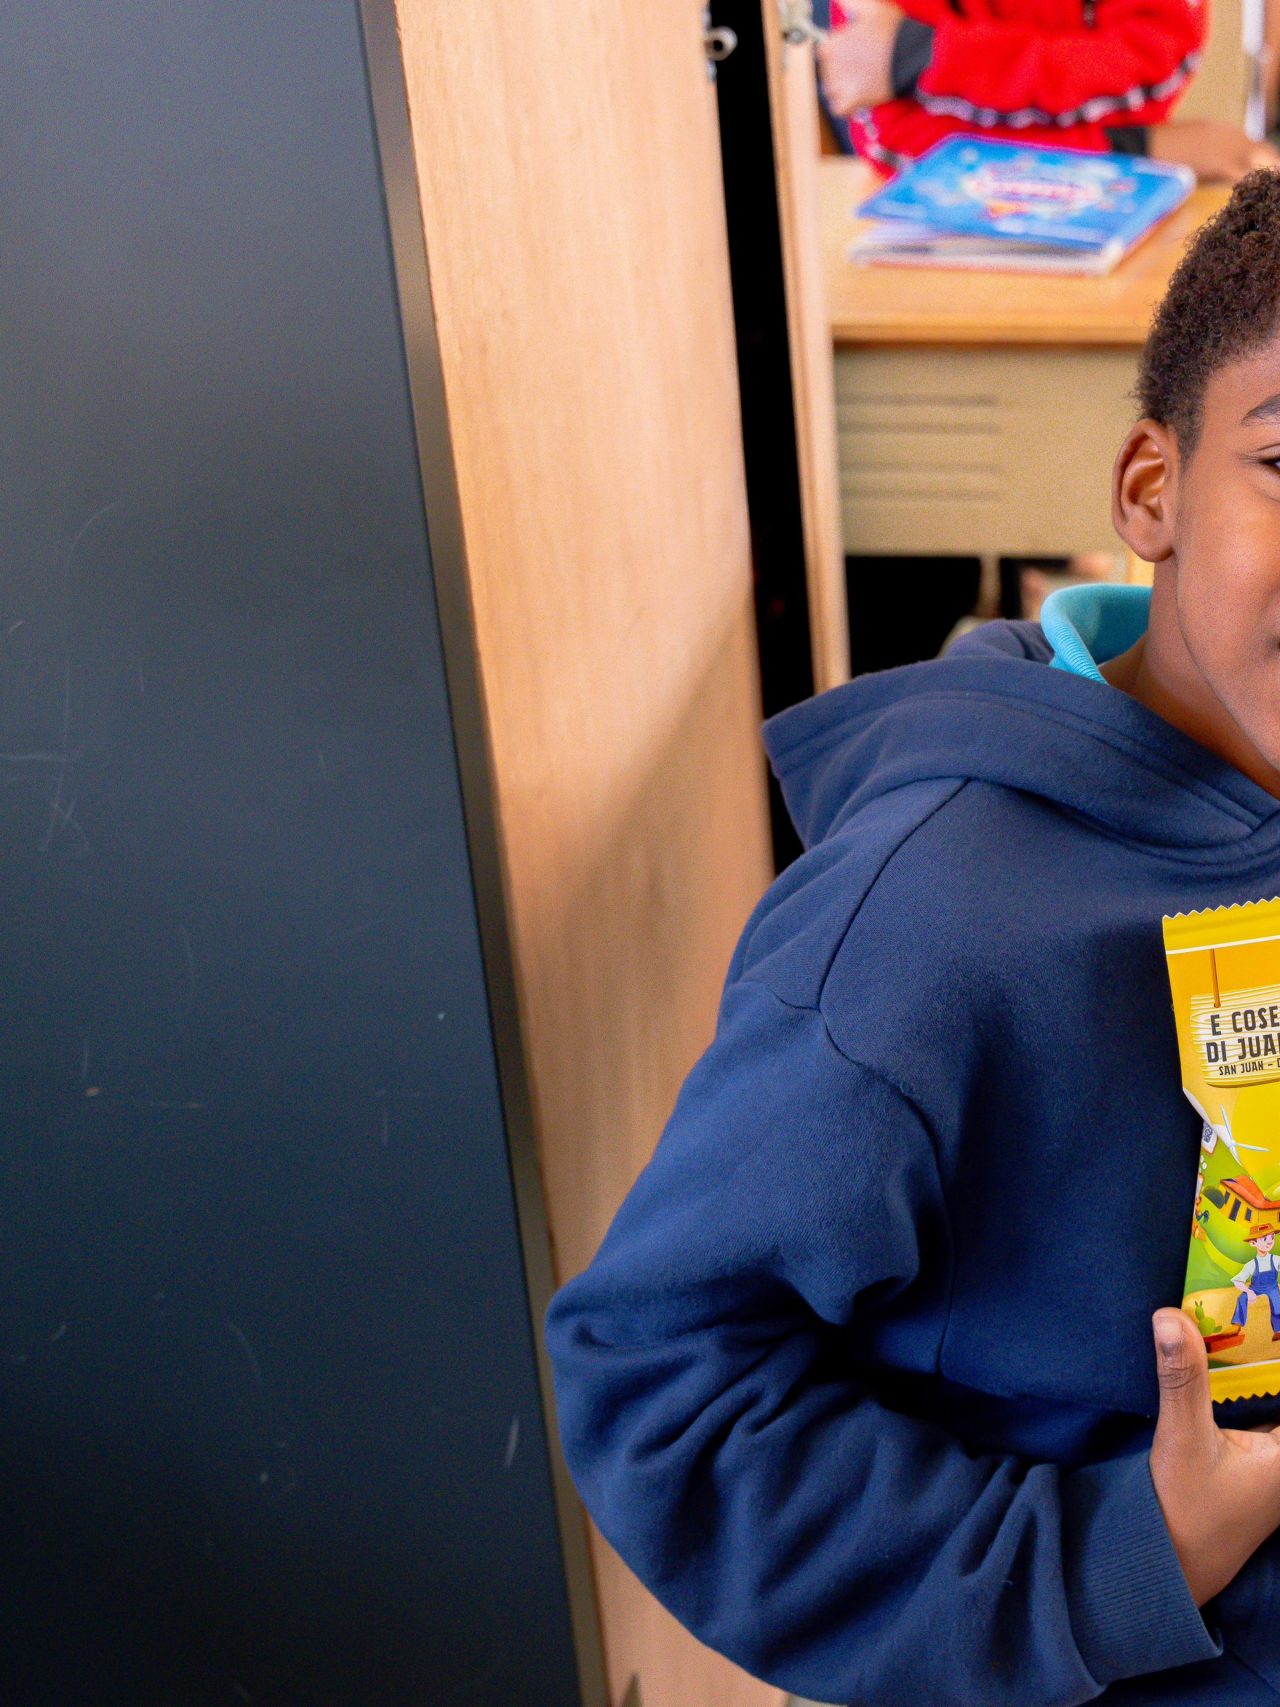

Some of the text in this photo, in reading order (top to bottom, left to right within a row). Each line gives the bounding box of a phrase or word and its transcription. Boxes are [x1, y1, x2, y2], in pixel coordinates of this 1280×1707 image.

[1210, 1014, 1221, 1036] E
[1206, 1041, 1227, 1063] DI
[1219, 1064, 1237, 1076] SAN
[1241, 1060, 1264, 1074] JUAN
